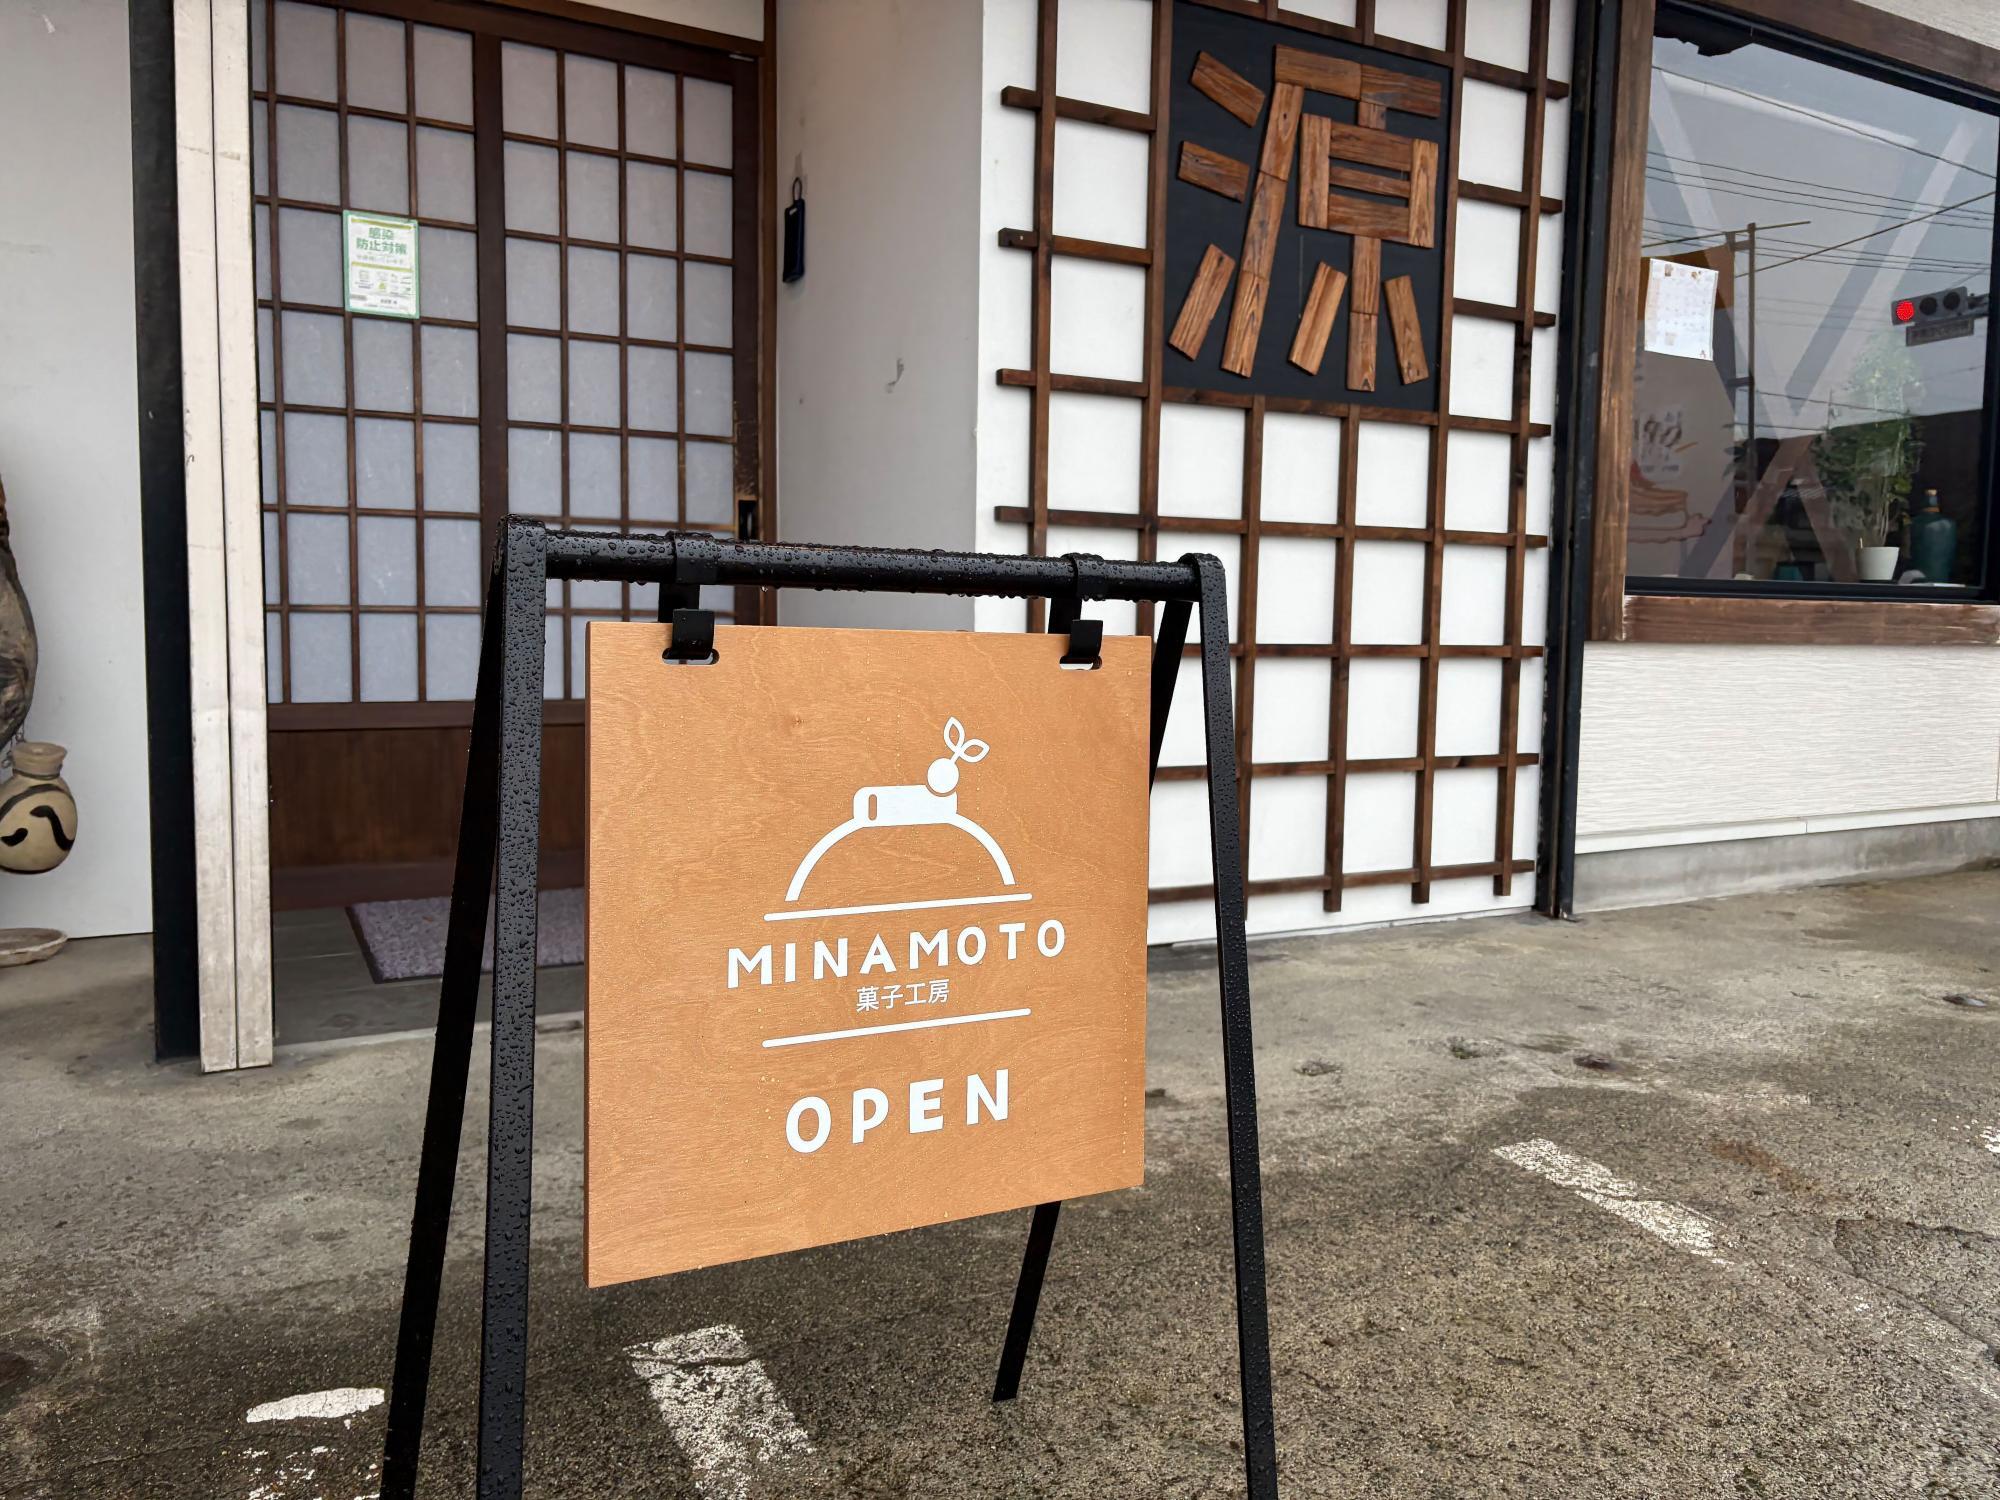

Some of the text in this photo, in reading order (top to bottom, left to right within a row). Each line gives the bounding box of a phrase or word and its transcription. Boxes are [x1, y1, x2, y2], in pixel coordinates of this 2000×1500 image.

[1168, 43, 1442, 392] 源
[727, 919, 1066, 989] MINAMOTO
[856, 978, 950, 1012] 菓子工房
[785, 1068, 1009, 1154] OPEN
